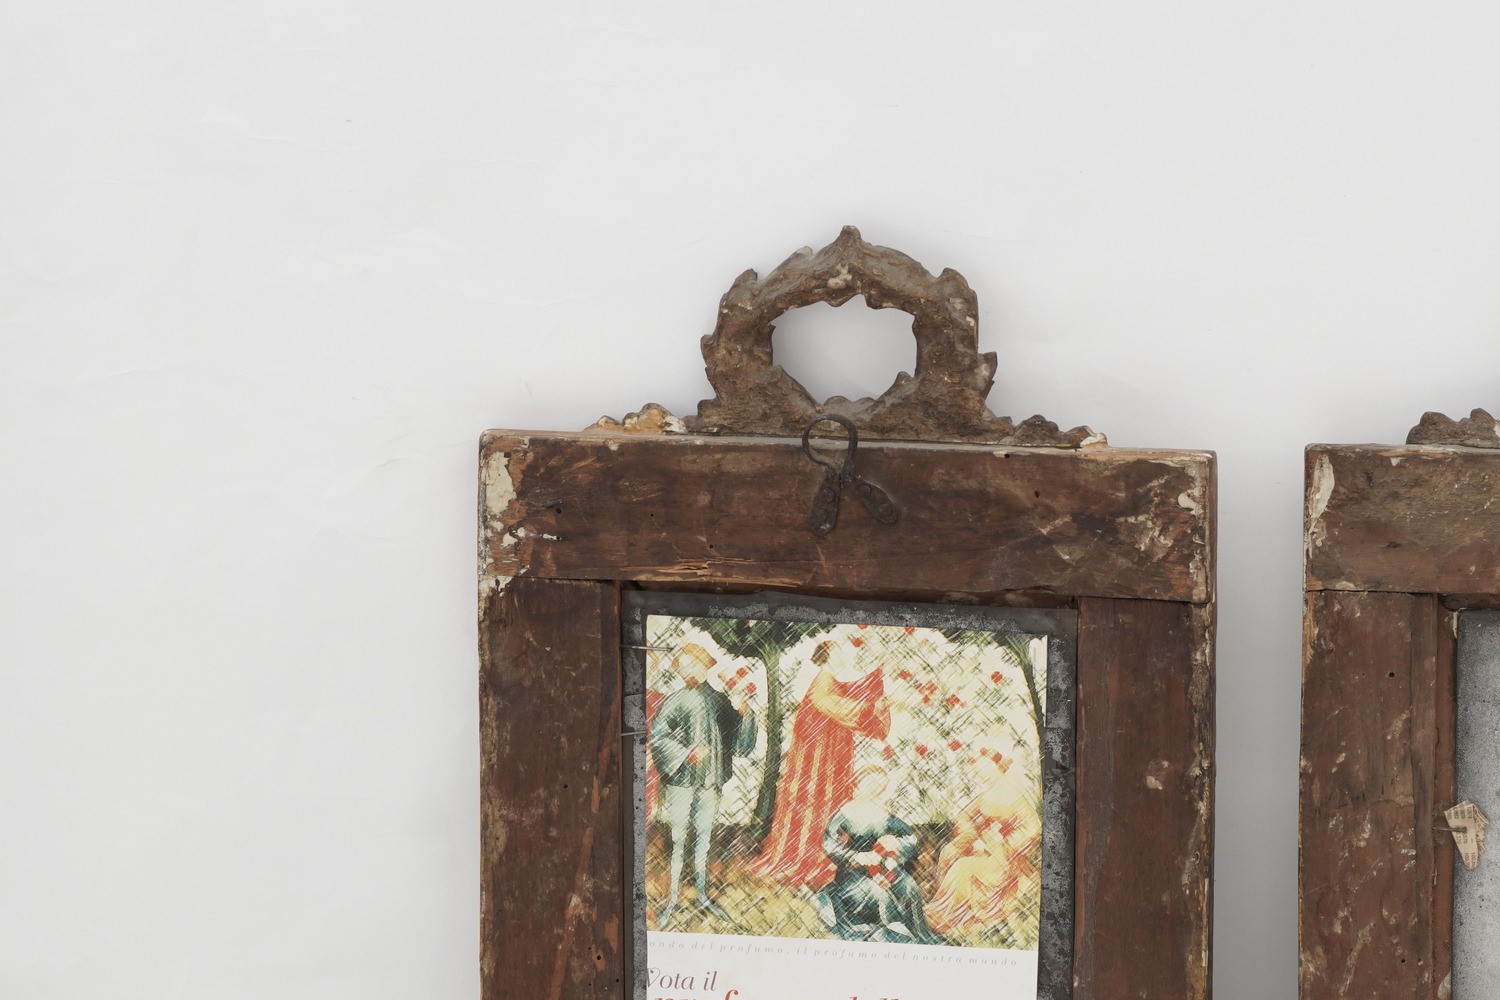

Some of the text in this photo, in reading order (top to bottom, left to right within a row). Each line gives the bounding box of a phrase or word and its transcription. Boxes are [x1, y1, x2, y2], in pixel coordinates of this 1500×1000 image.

[692, 941, 714, 950] del
[813, 948, 877, 958] profumo
[884, 950, 906, 959] del
[913, 953, 962, 963] nostro
[969, 956, 1018, 966] mondo
[646, 967, 718, 991] Vota il
